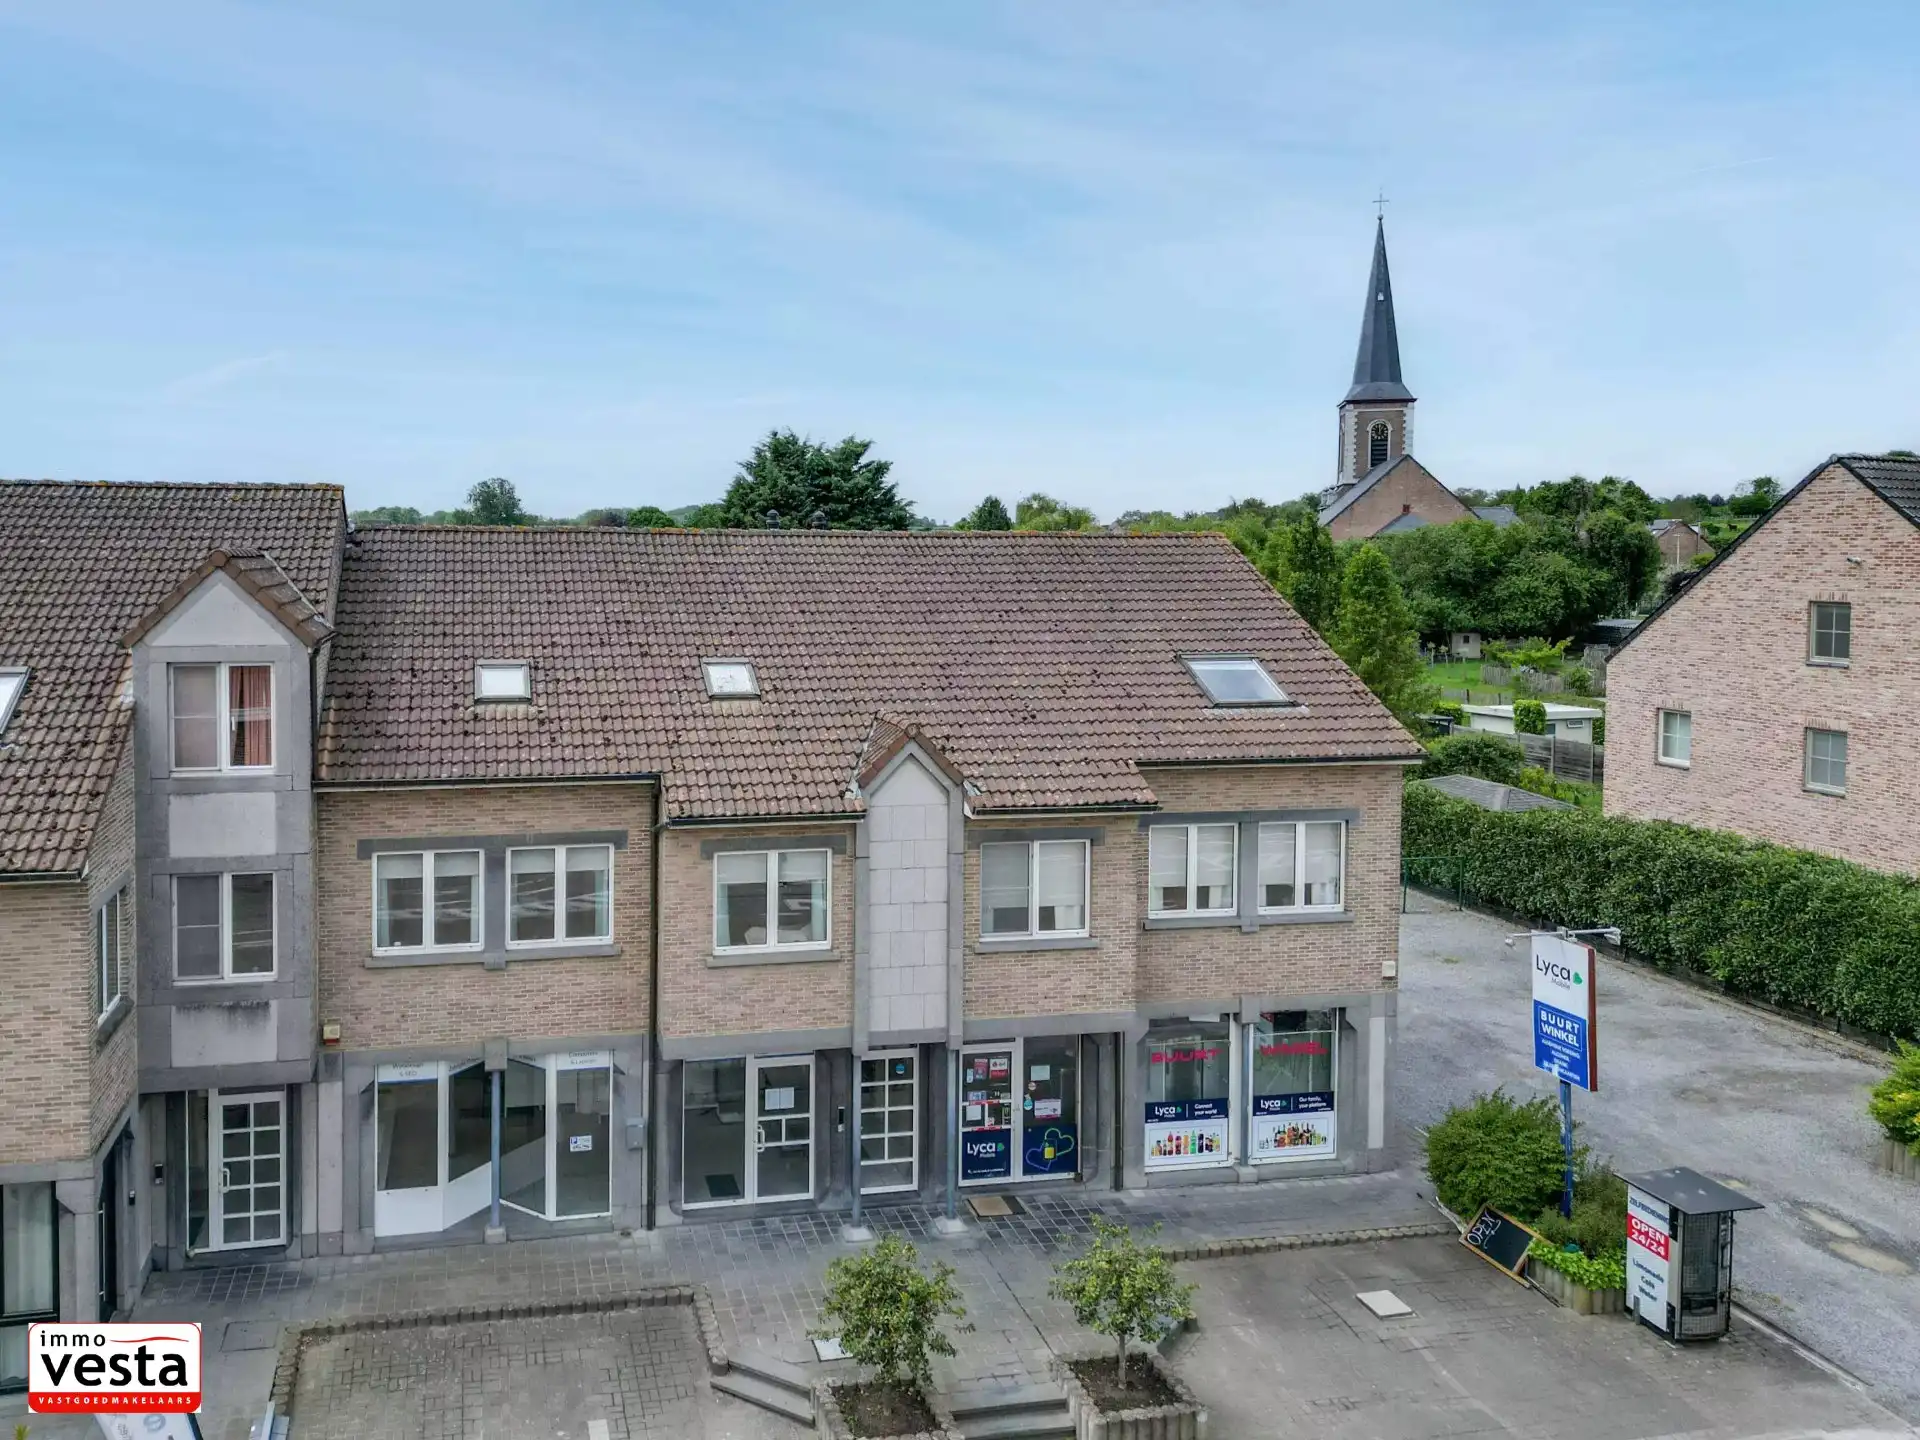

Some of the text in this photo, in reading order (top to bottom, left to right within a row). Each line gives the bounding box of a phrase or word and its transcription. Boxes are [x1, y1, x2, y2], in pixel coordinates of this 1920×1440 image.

[1536, 953, 1571, 982] Lyca
[1540, 1010, 1580, 1035] BUURT
[1541, 1021, 1580, 1048] WINKEL
[1155, 1105, 1176, 1116] Lyca
[1260, 1099, 1281, 1109] Lyca
[967, 1142, 996, 1156] Lyca
[1467, 1209, 1496, 1246] OPEN
[1631, 1217, 1665, 1244] OPEN
[1631, 1229, 1665, 1256] 24/24
